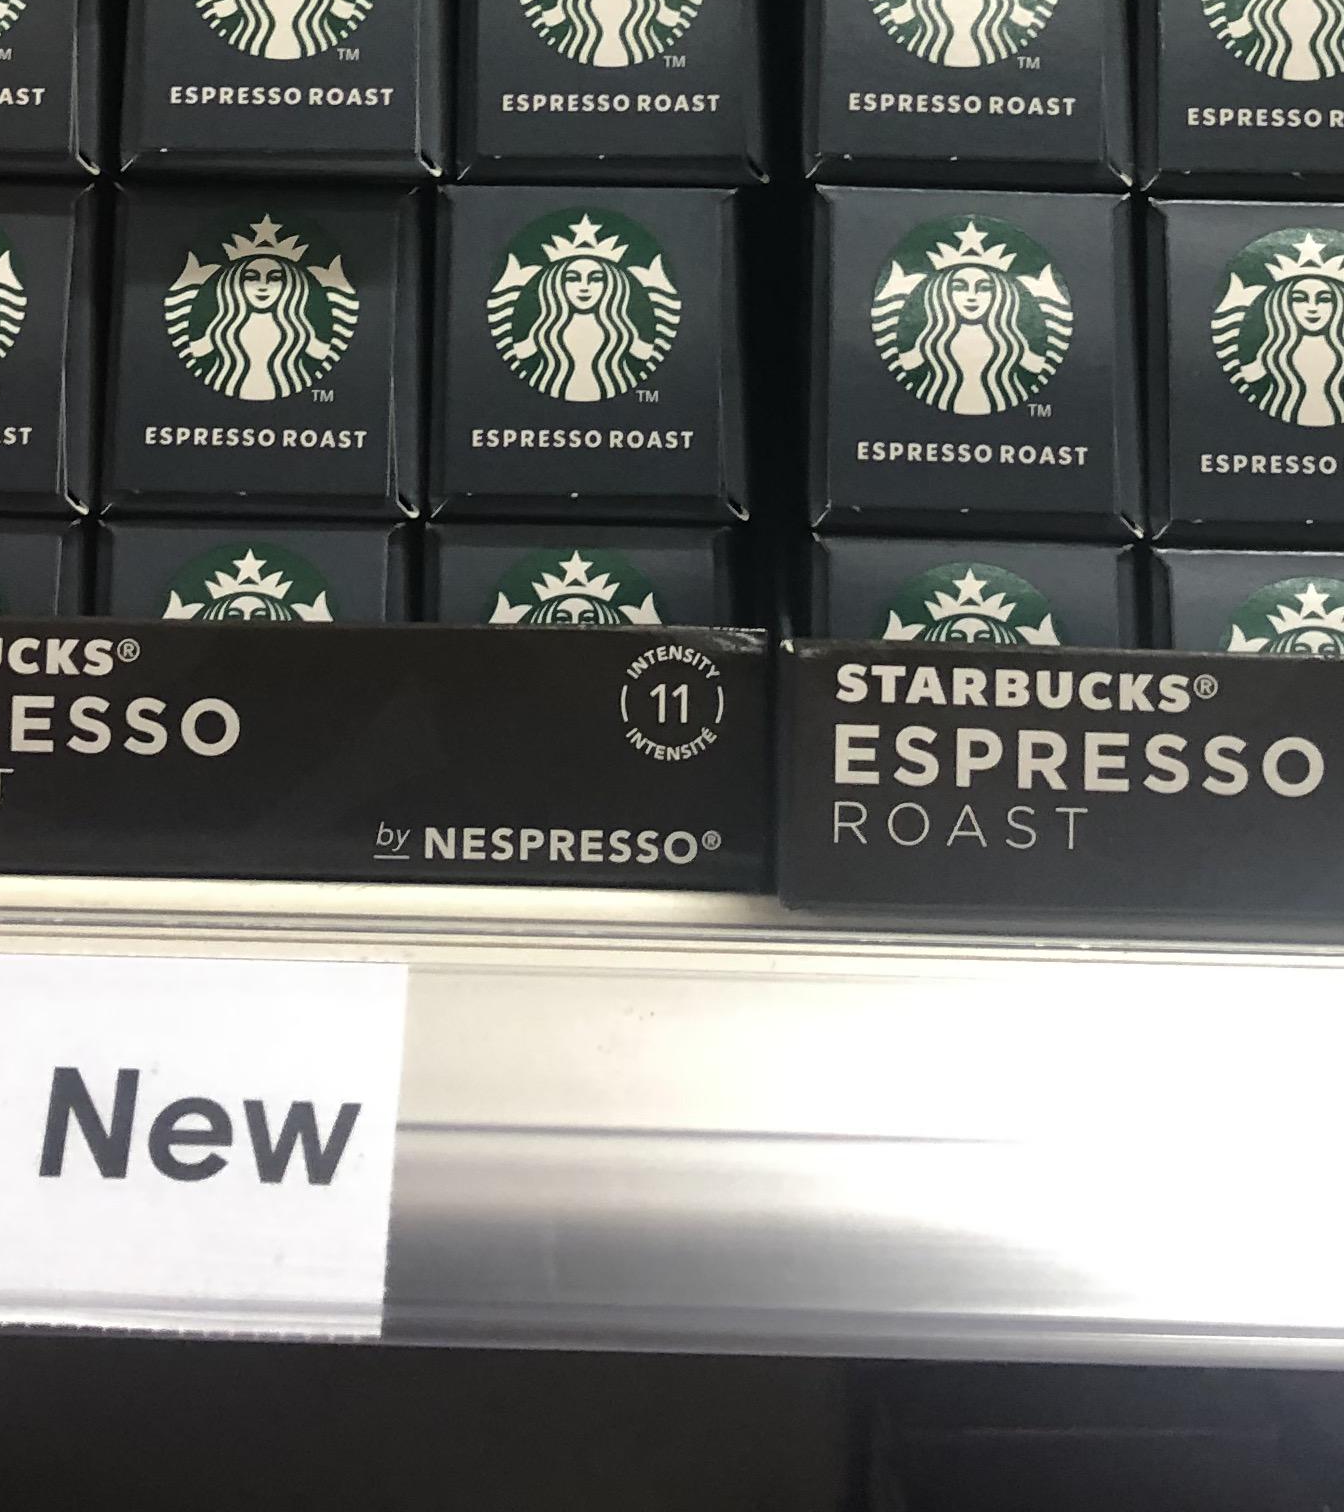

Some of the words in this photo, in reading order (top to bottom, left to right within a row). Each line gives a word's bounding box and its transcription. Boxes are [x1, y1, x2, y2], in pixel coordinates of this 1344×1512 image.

[171, 87, 301, 104] ESPRESSO
[309, 88, 393, 105] ROAST
[503, 94, 629, 111] ESPRESSO
[638, 95, 719, 112] ROAST
[849, 93, 981, 113] ESPRESSO
[990, 97, 1074, 115] ROAST
[1188, 108, 1322, 127] ESPRESSO
[146, 427, 275, 446] ESPRESSO
[283, 430, 367, 448] ROAST
[473, 430, 602, 447] ESPRESSO
[610, 431, 693, 448] ROAST
[858, 442, 992, 463] ESPRESSO
[1000, 445, 1088, 465] ROAST
[1201, 454, 1337, 474] ESPRESSO
[626, 645, 720, 679] INTENSITY
[649, 683, 688, 723] 11
[835, 724, 1324, 797] ESPRESSO
[375, 822, 410, 850] by
[834, 801, 1088, 849] ROAST
[39, 1067, 361, 1185] New
